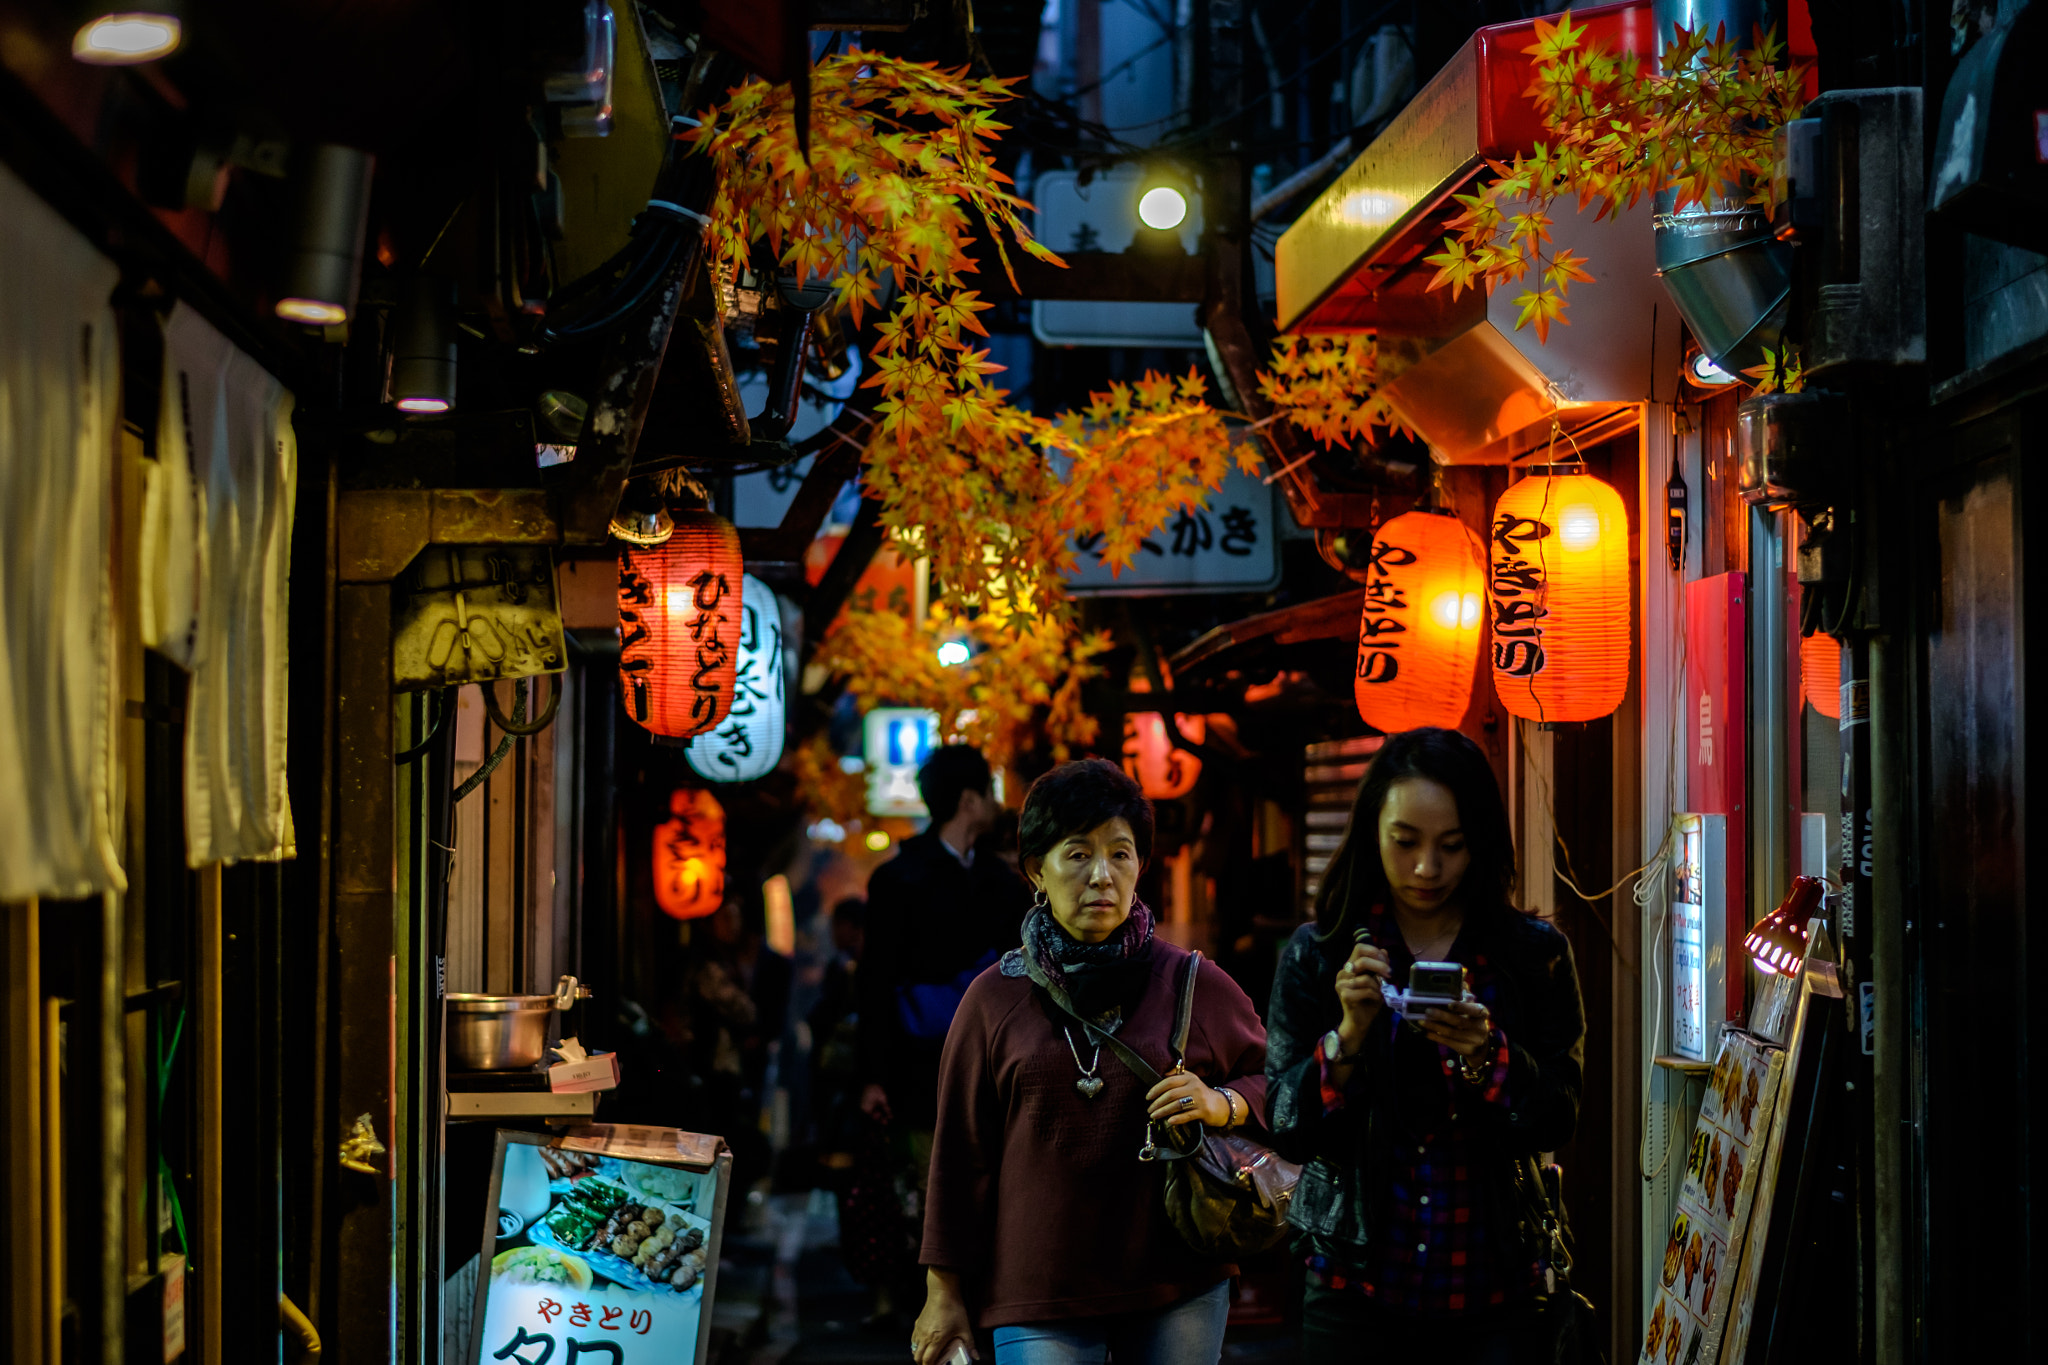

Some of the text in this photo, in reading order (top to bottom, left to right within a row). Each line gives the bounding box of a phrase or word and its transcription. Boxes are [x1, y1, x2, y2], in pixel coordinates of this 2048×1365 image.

[686, 569, 731, 732] ひなどり
[537, 1298, 652, 1335] やきとり
